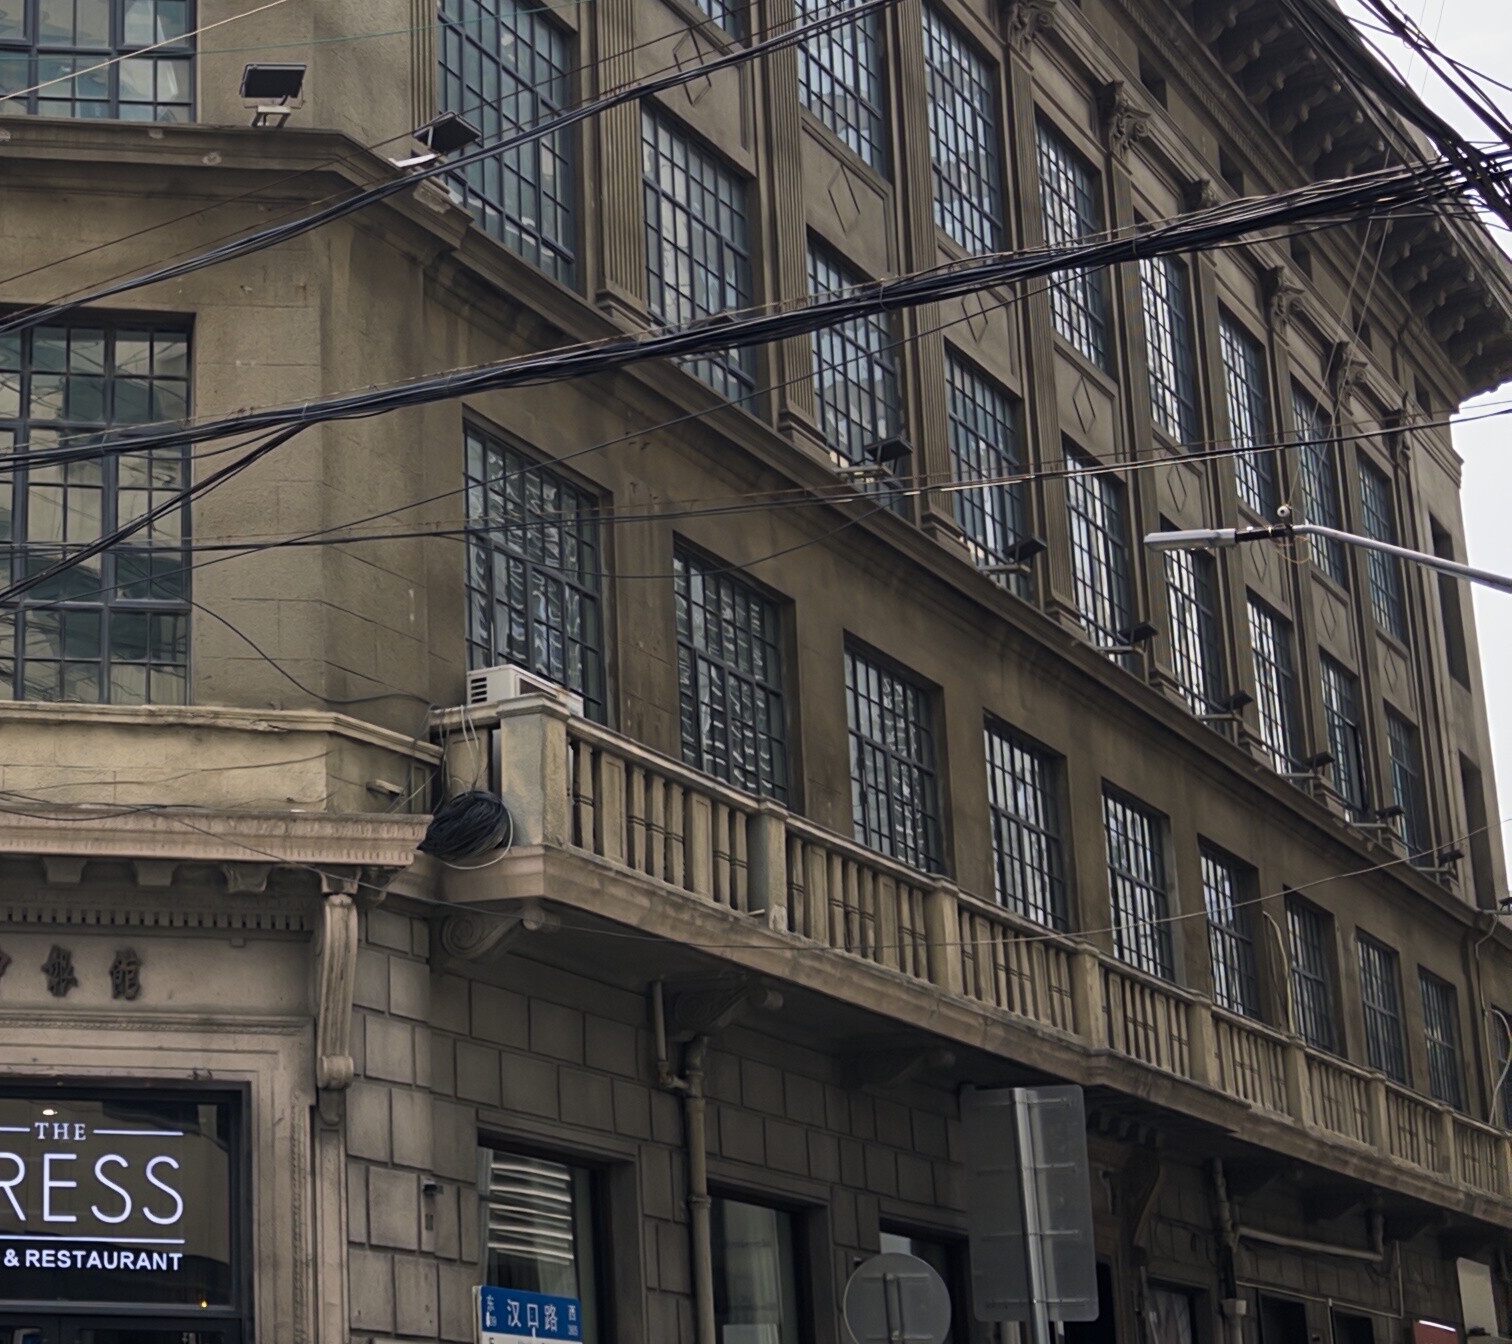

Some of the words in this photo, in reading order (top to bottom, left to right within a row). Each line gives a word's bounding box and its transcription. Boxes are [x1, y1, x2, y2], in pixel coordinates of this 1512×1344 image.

[34, 1122, 86, 1141] THE
[4, 1249, 20, 1267] &
[25, 1249, 183, 1271] RESTAURANT
[507, 1298, 558, 1333] 汉口路
